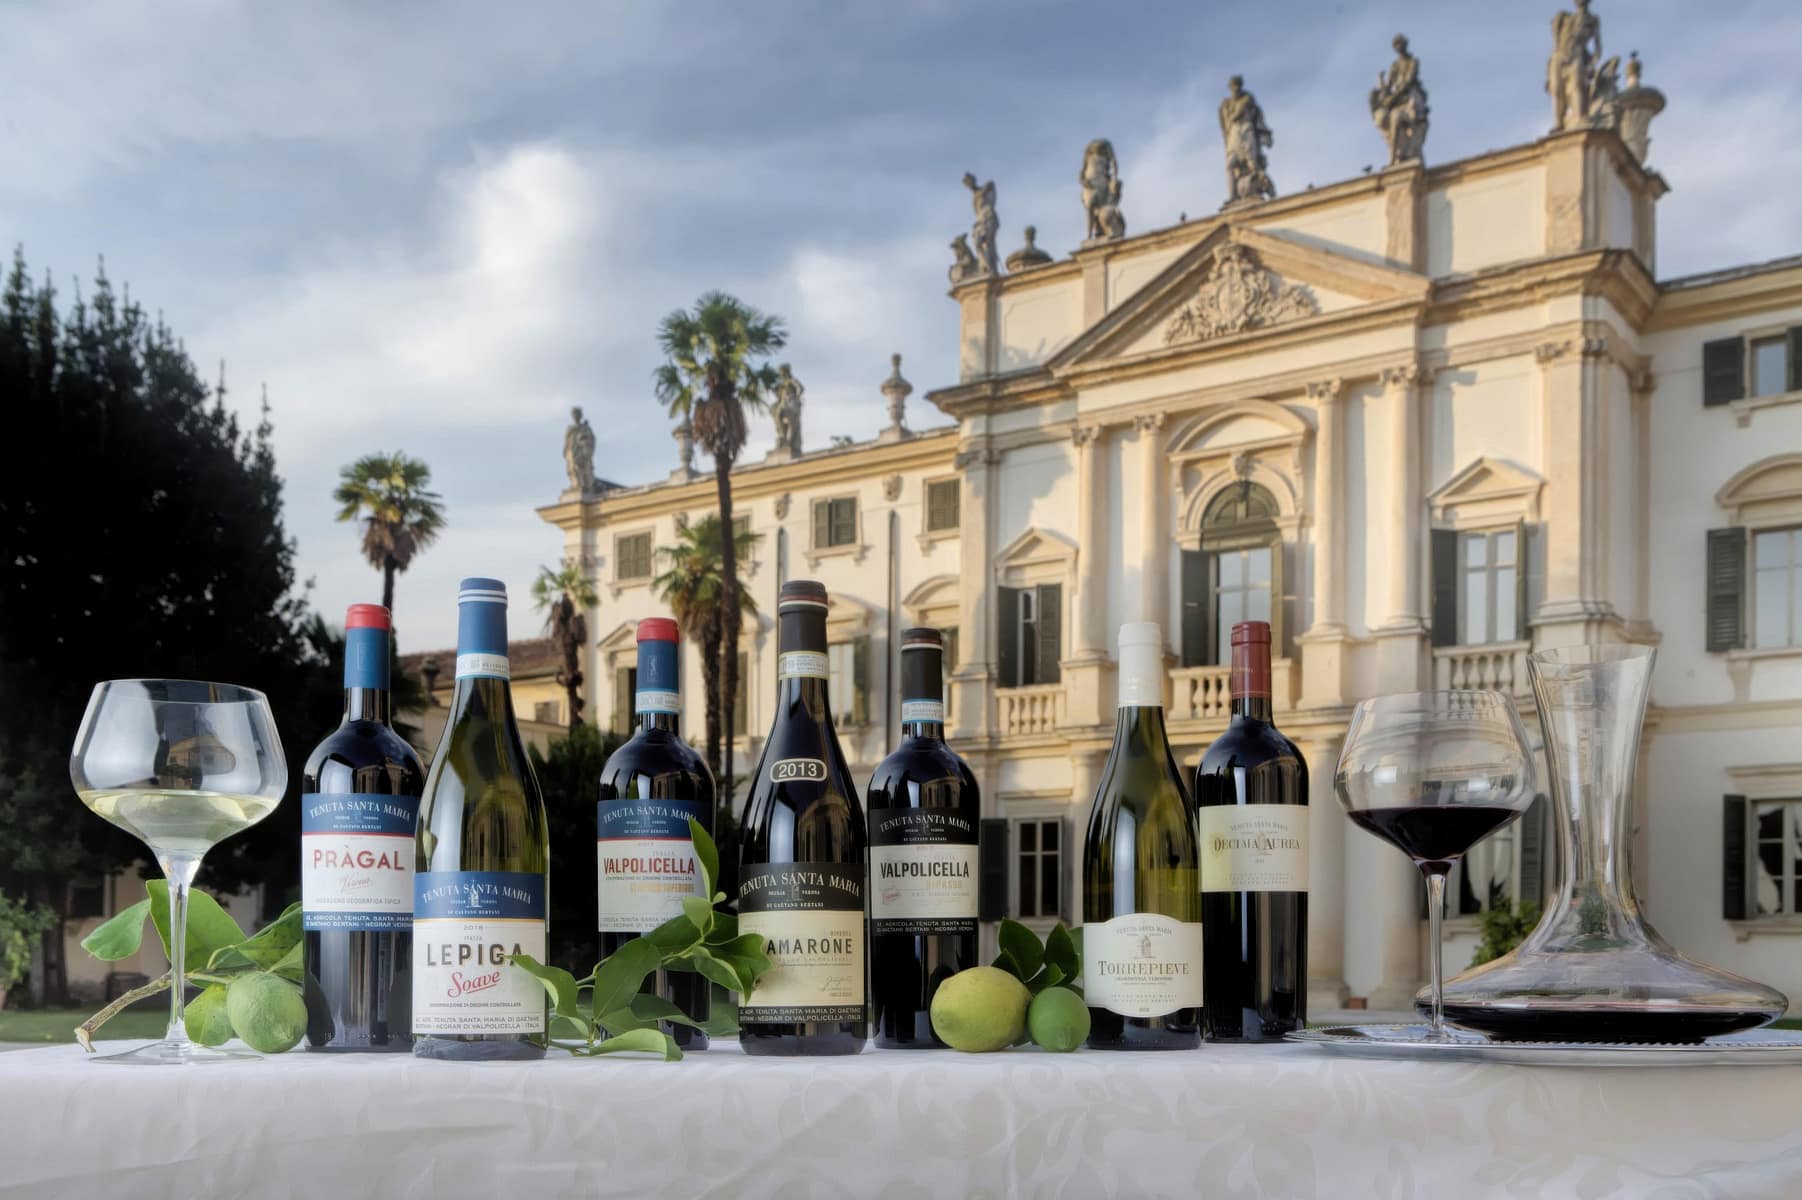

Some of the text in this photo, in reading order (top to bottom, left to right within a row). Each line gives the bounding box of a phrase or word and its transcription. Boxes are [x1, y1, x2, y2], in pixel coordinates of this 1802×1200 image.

[778, 762, 818, 778] 2013
[309, 800, 410, 822] TENUTA SANTA MARIA
[603, 807, 634, 824] TENUTA
[637, 805, 668, 817] SANTA
[880, 814, 970, 832] TENUTA SANTA MARIA
[1213, 838, 1301, 851] DECIMA AUREA
[313, 844, 405, 871] PRÀGAL
[603, 856, 696, 875] VALPOLICELLA
[880, 861, 970, 879] VALPOLICELLA
[423, 883, 532, 905] TENUTA SANTA MARIA
[739, 872, 860, 899] TENUTA SANTA MARIA
[427, 943, 522, 966] LEPIGA
[766, 938, 853, 955] AMARONE
[1097, 960, 1190, 976] TORREPIEVE
[447, 970, 502, 998] Soave
